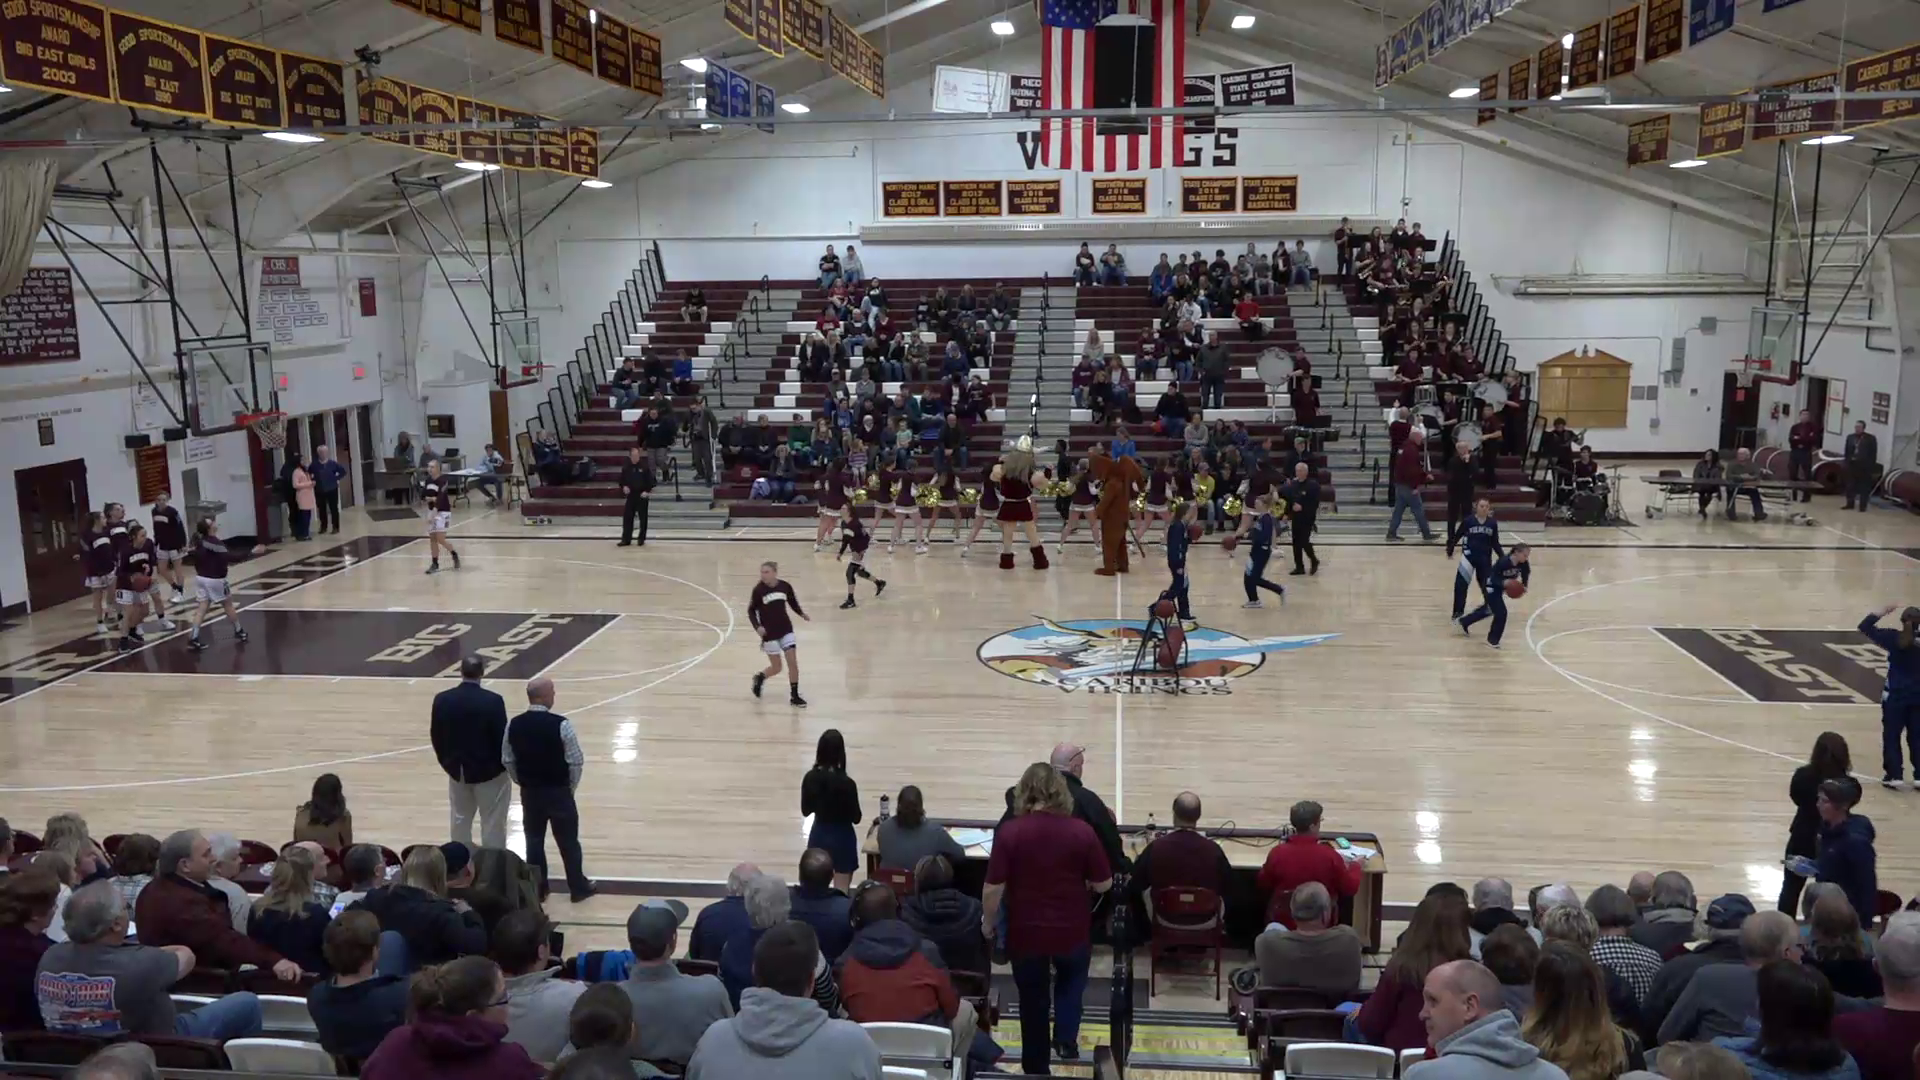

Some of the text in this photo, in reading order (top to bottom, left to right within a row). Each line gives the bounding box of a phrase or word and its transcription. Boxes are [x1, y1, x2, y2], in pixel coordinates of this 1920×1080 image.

[37, 45, 64, 63] EAST
[67, 53, 96, 70] GIRLS
[41, 66, 76, 84] 2003
[1857, 61, 1889, 82] CARIBOU
[365, 623, 472, 663] BIG
[1702, 628, 1877, 704] EAST
